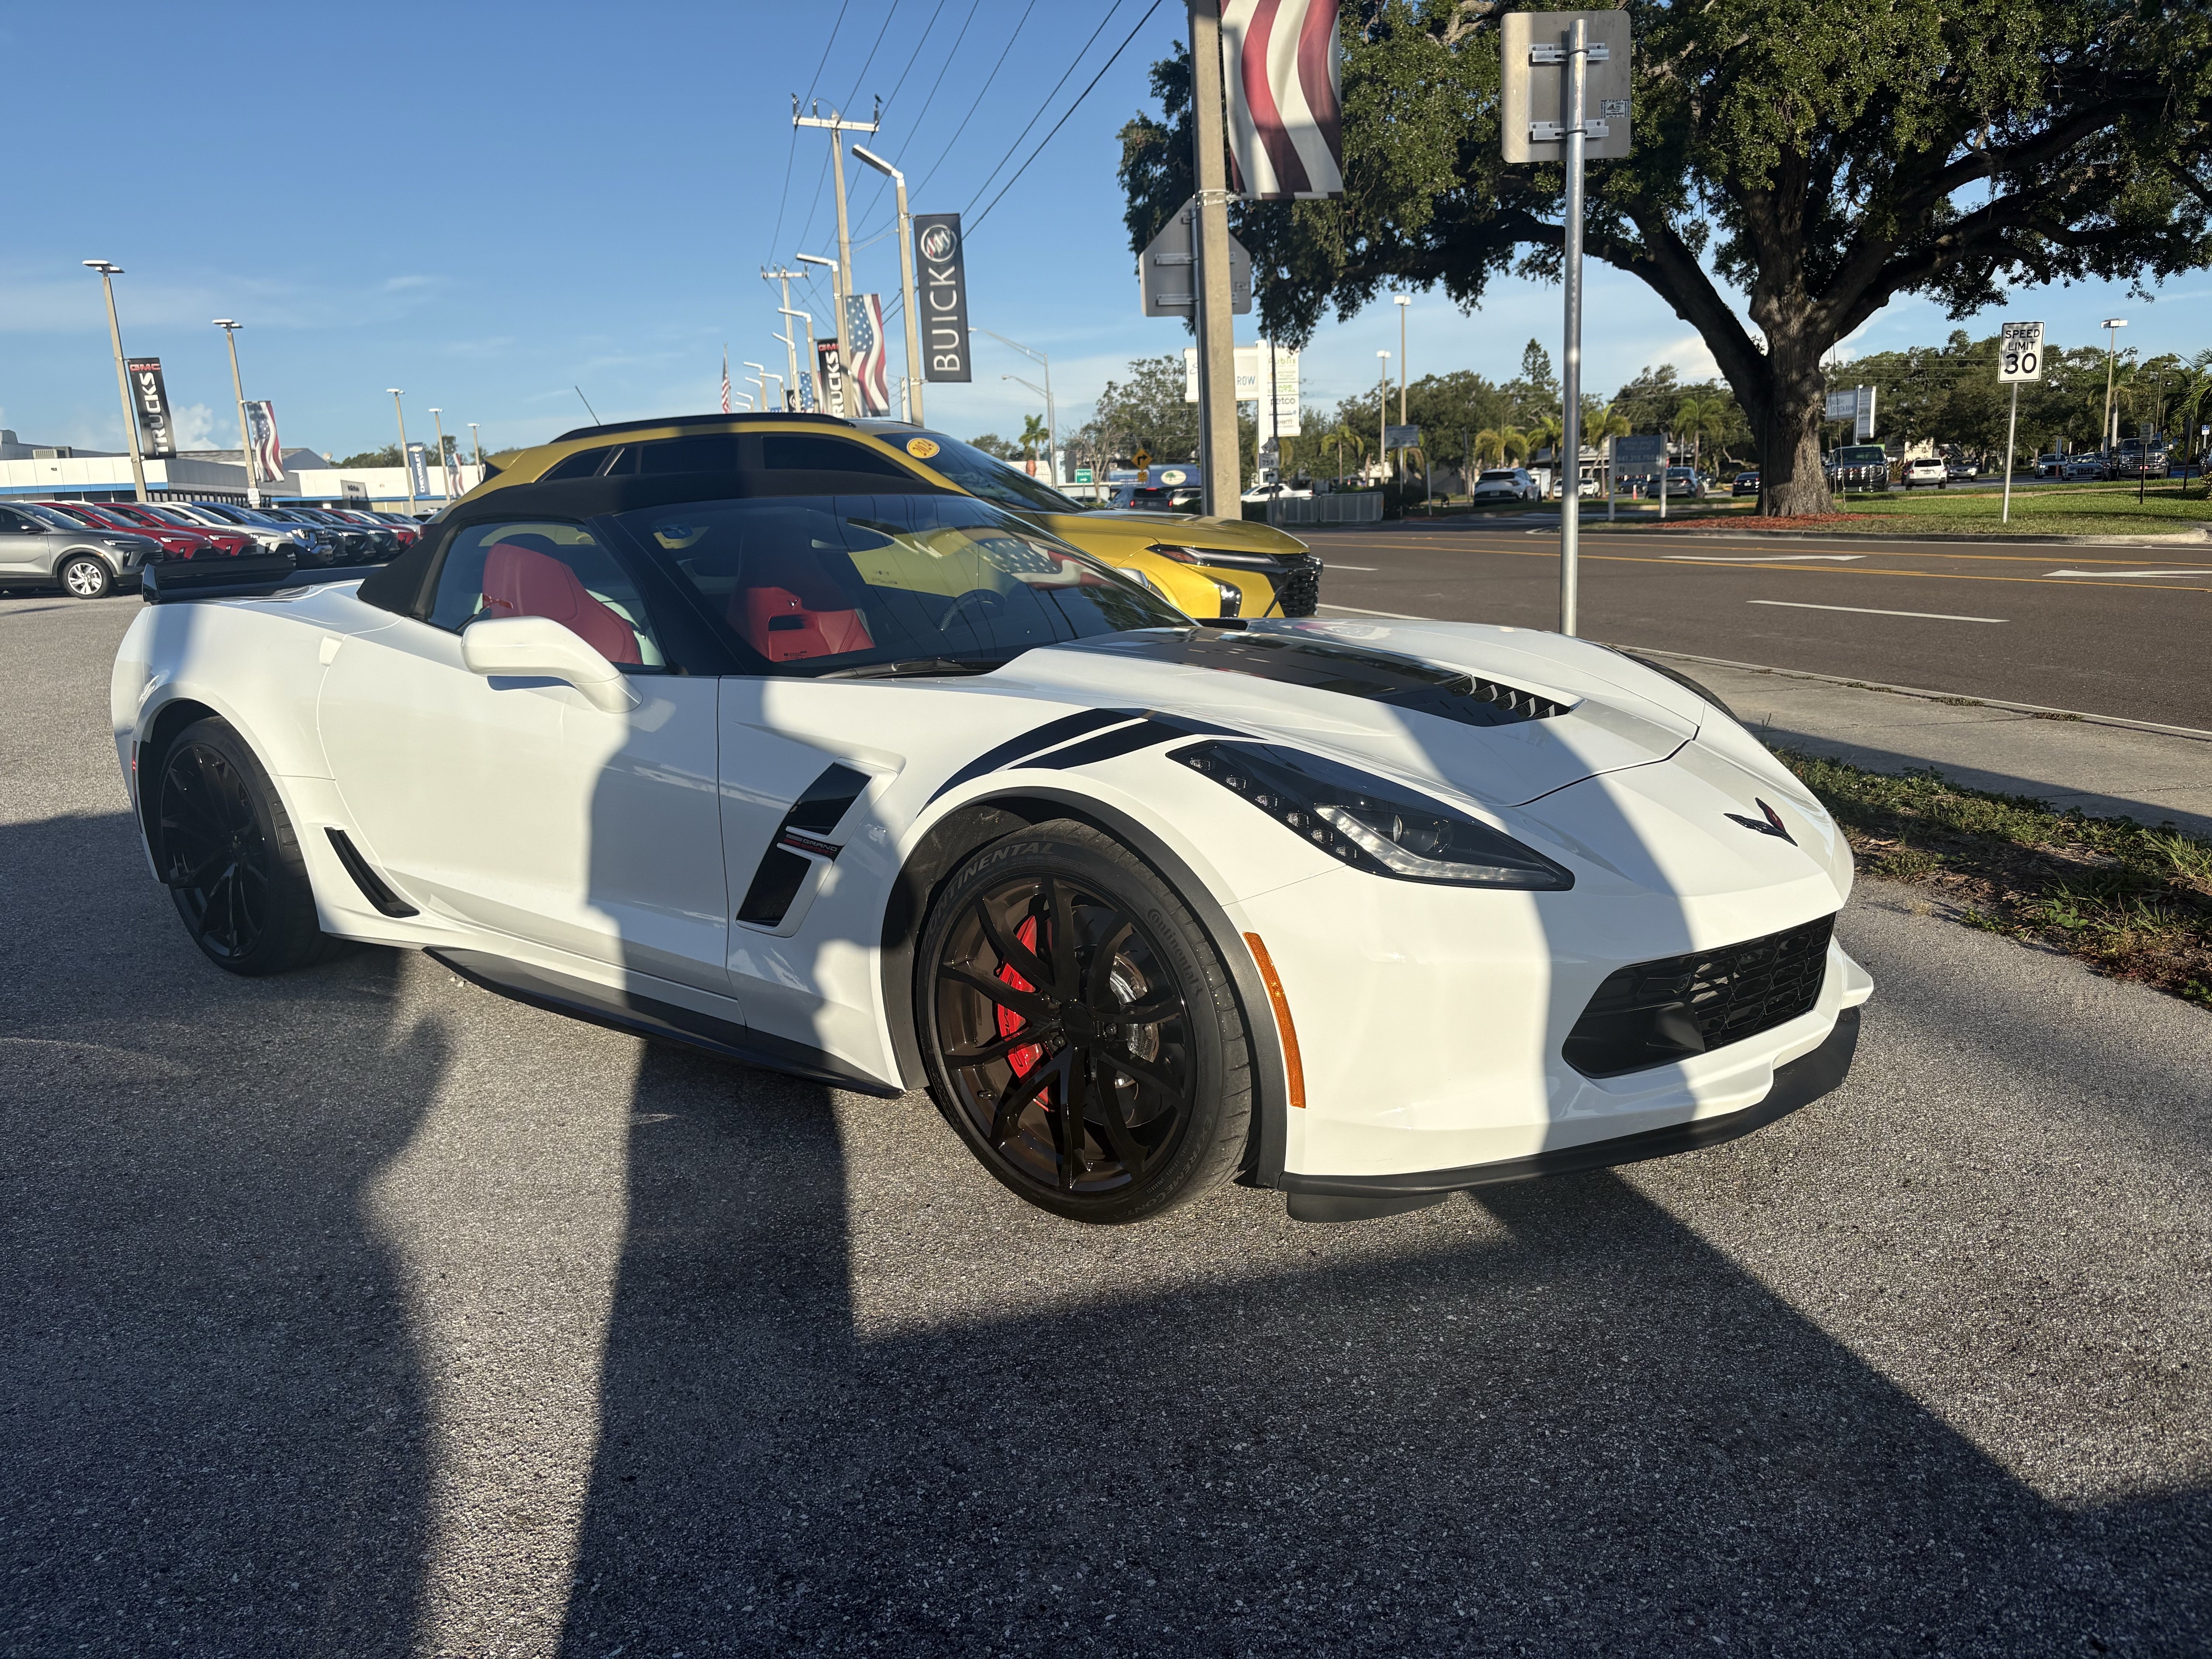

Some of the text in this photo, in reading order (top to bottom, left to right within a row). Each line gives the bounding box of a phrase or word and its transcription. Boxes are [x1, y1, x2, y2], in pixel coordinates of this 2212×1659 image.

[928, 266, 960, 371] BUICK
[2005, 329, 2040, 338] SPEED
[818, 343, 840, 352] GM
[2008, 342, 2035, 351] LIMIT
[130, 363, 161, 372] GMC
[2004, 353, 2037, 374] 30
[825, 351, 845, 418] RUCKS
[1237, 375, 1256, 386] ROW
[139, 372, 169, 456] TRUCKS
[913, 439, 934, 456] 2024
[414, 453, 425, 493] CHEVROLET
[803, 839, 837, 852] GRAND
[922, 842, 1056, 953] CONTINENTAL
[1146, 908, 1200, 985] Continental
[1125, 1114, 1213, 1217] EXTREMECONT
